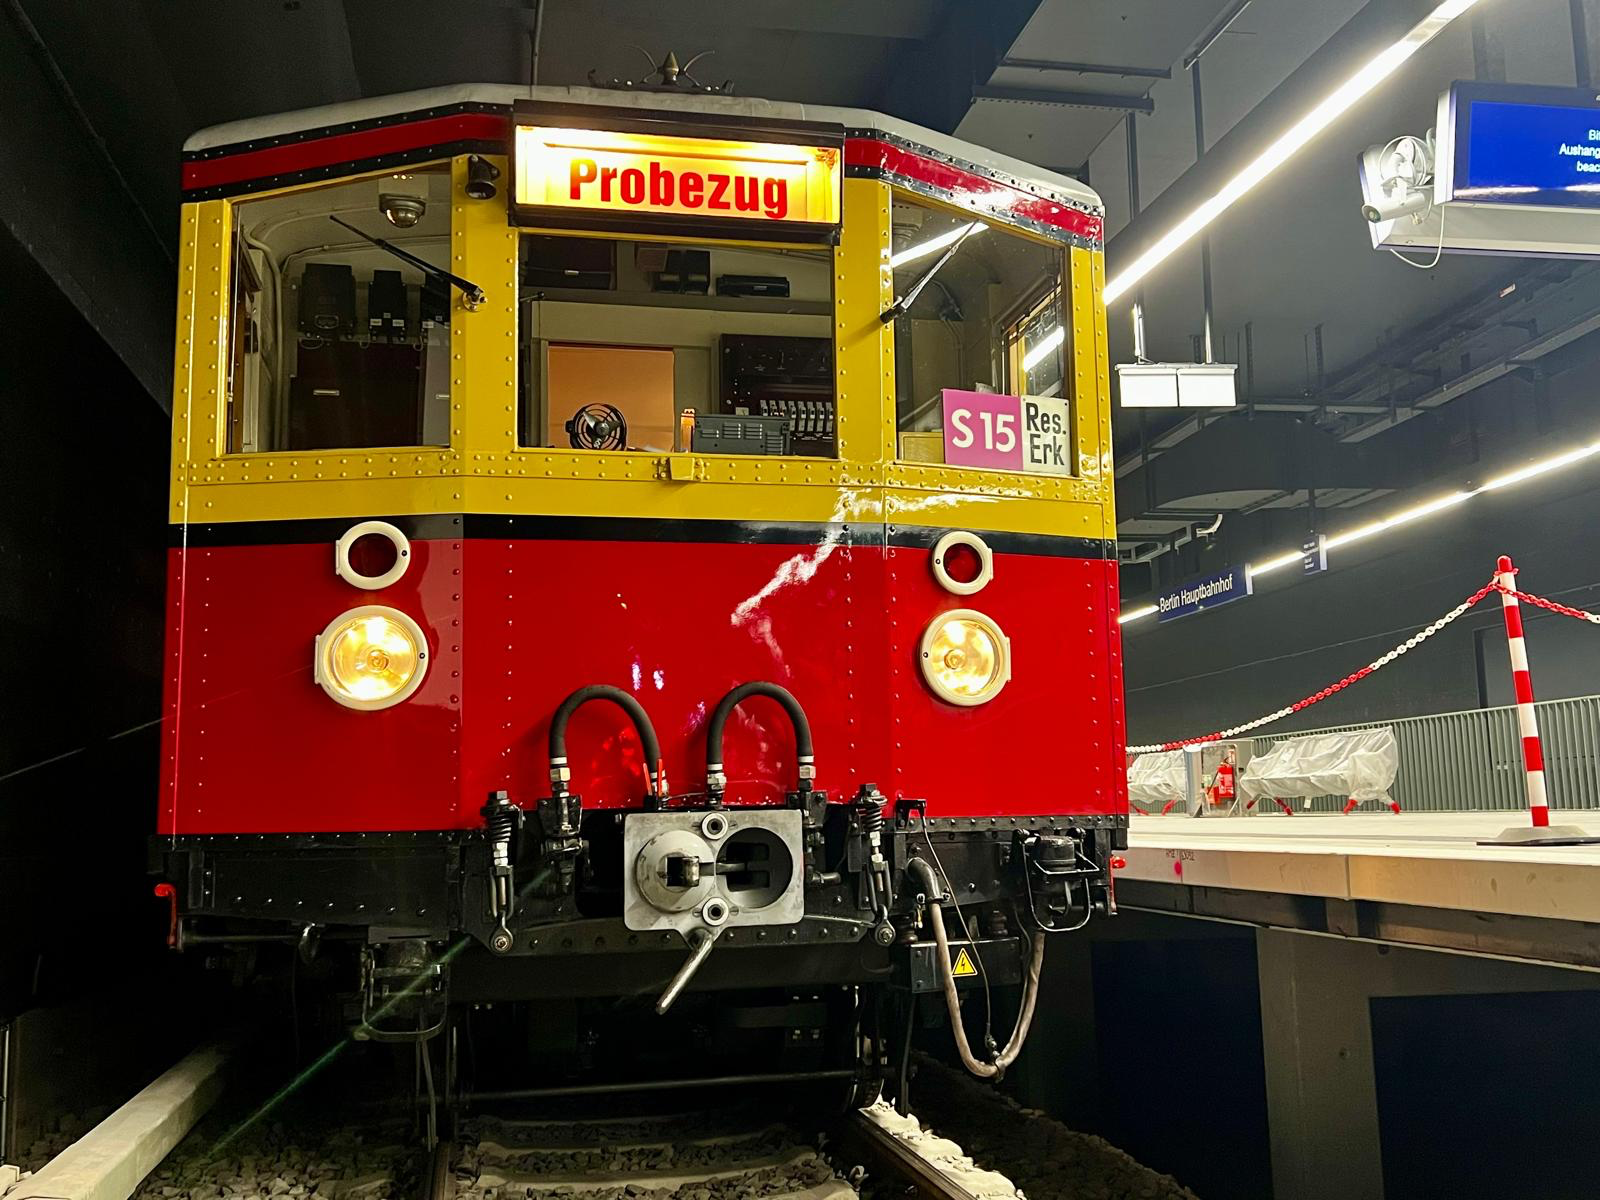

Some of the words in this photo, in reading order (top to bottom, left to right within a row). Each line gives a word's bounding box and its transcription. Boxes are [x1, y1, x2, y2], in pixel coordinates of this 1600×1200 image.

[570, 158, 788, 219] Probezug
[951, 408, 974, 448] S
[979, 411, 1016, 453] 15
[1025, 402, 1067, 435] Res.
[1029, 433, 1065, 466] Erk
[1160, 593, 1180, 613] Berlin
[1180, 573, 1233, 605] Hauptbahnhof
